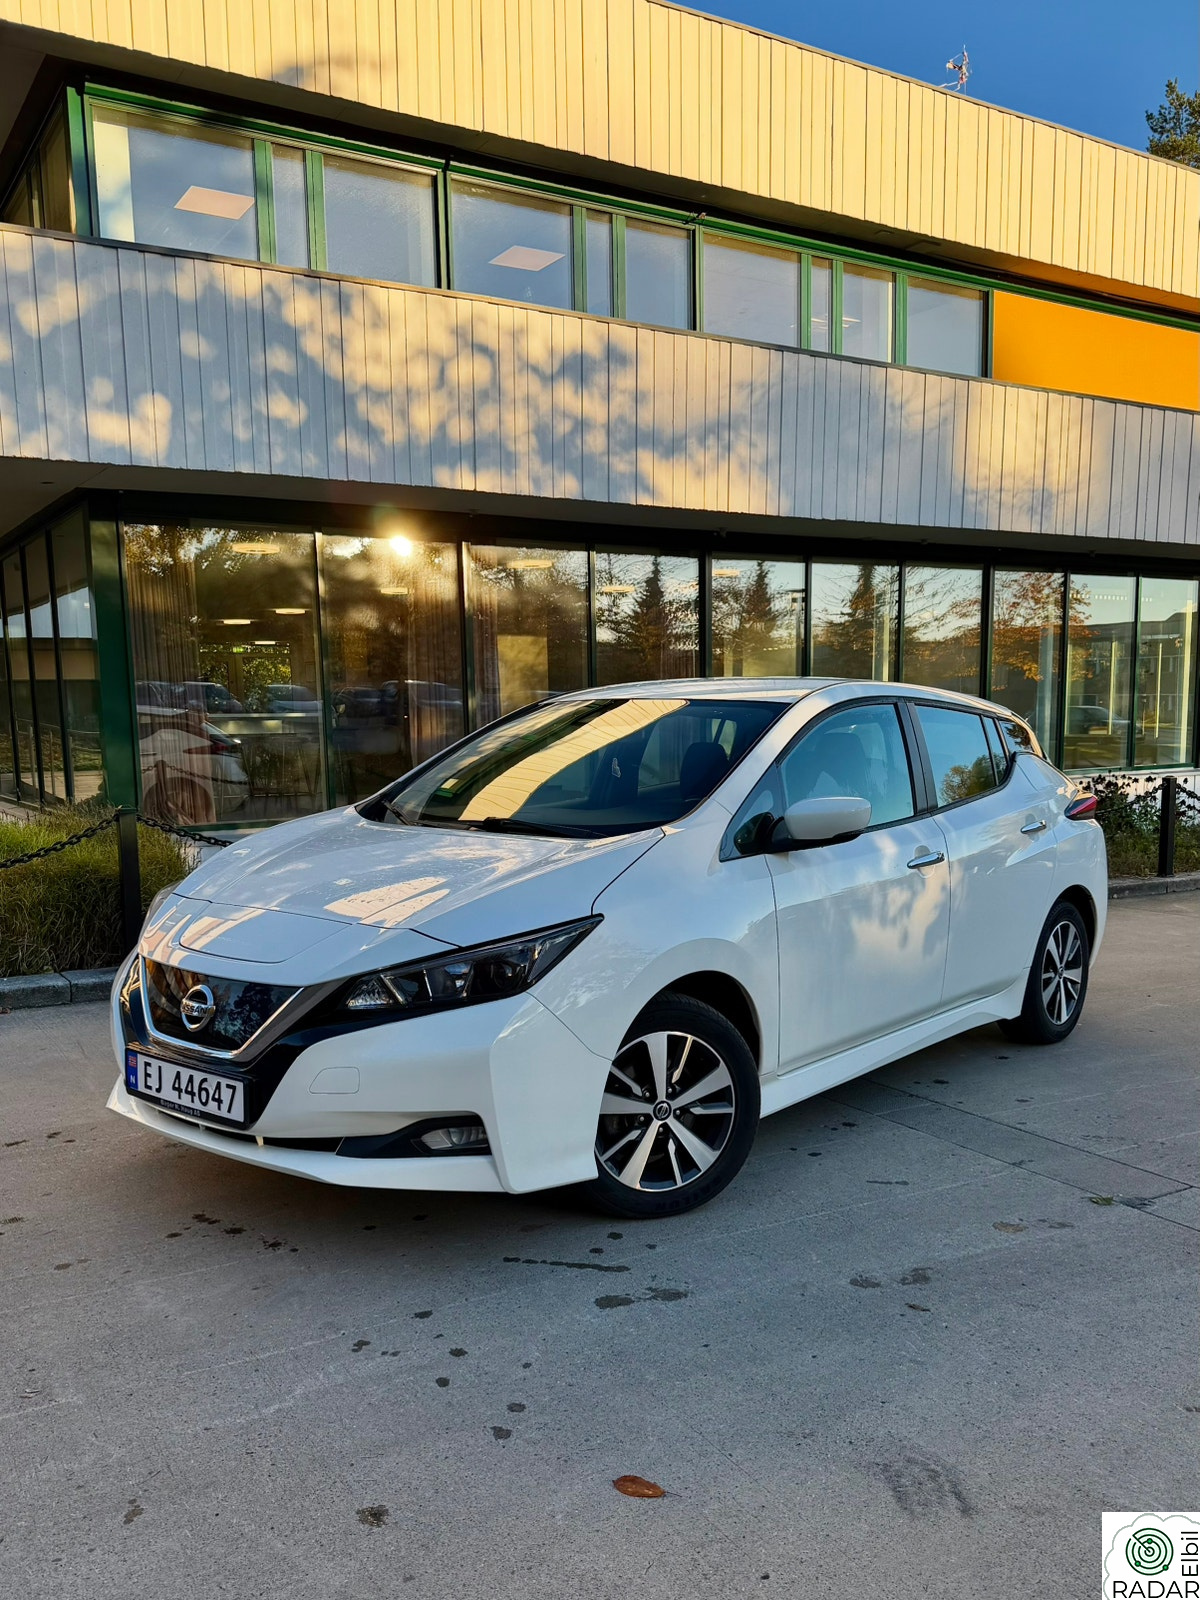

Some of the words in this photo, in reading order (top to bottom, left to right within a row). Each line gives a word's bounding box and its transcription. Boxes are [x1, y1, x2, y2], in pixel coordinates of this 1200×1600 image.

[130, 1074, 136, 1084] N
[144, 1061, 162, 1093] EJ
[172, 1070, 237, 1114] 44647
